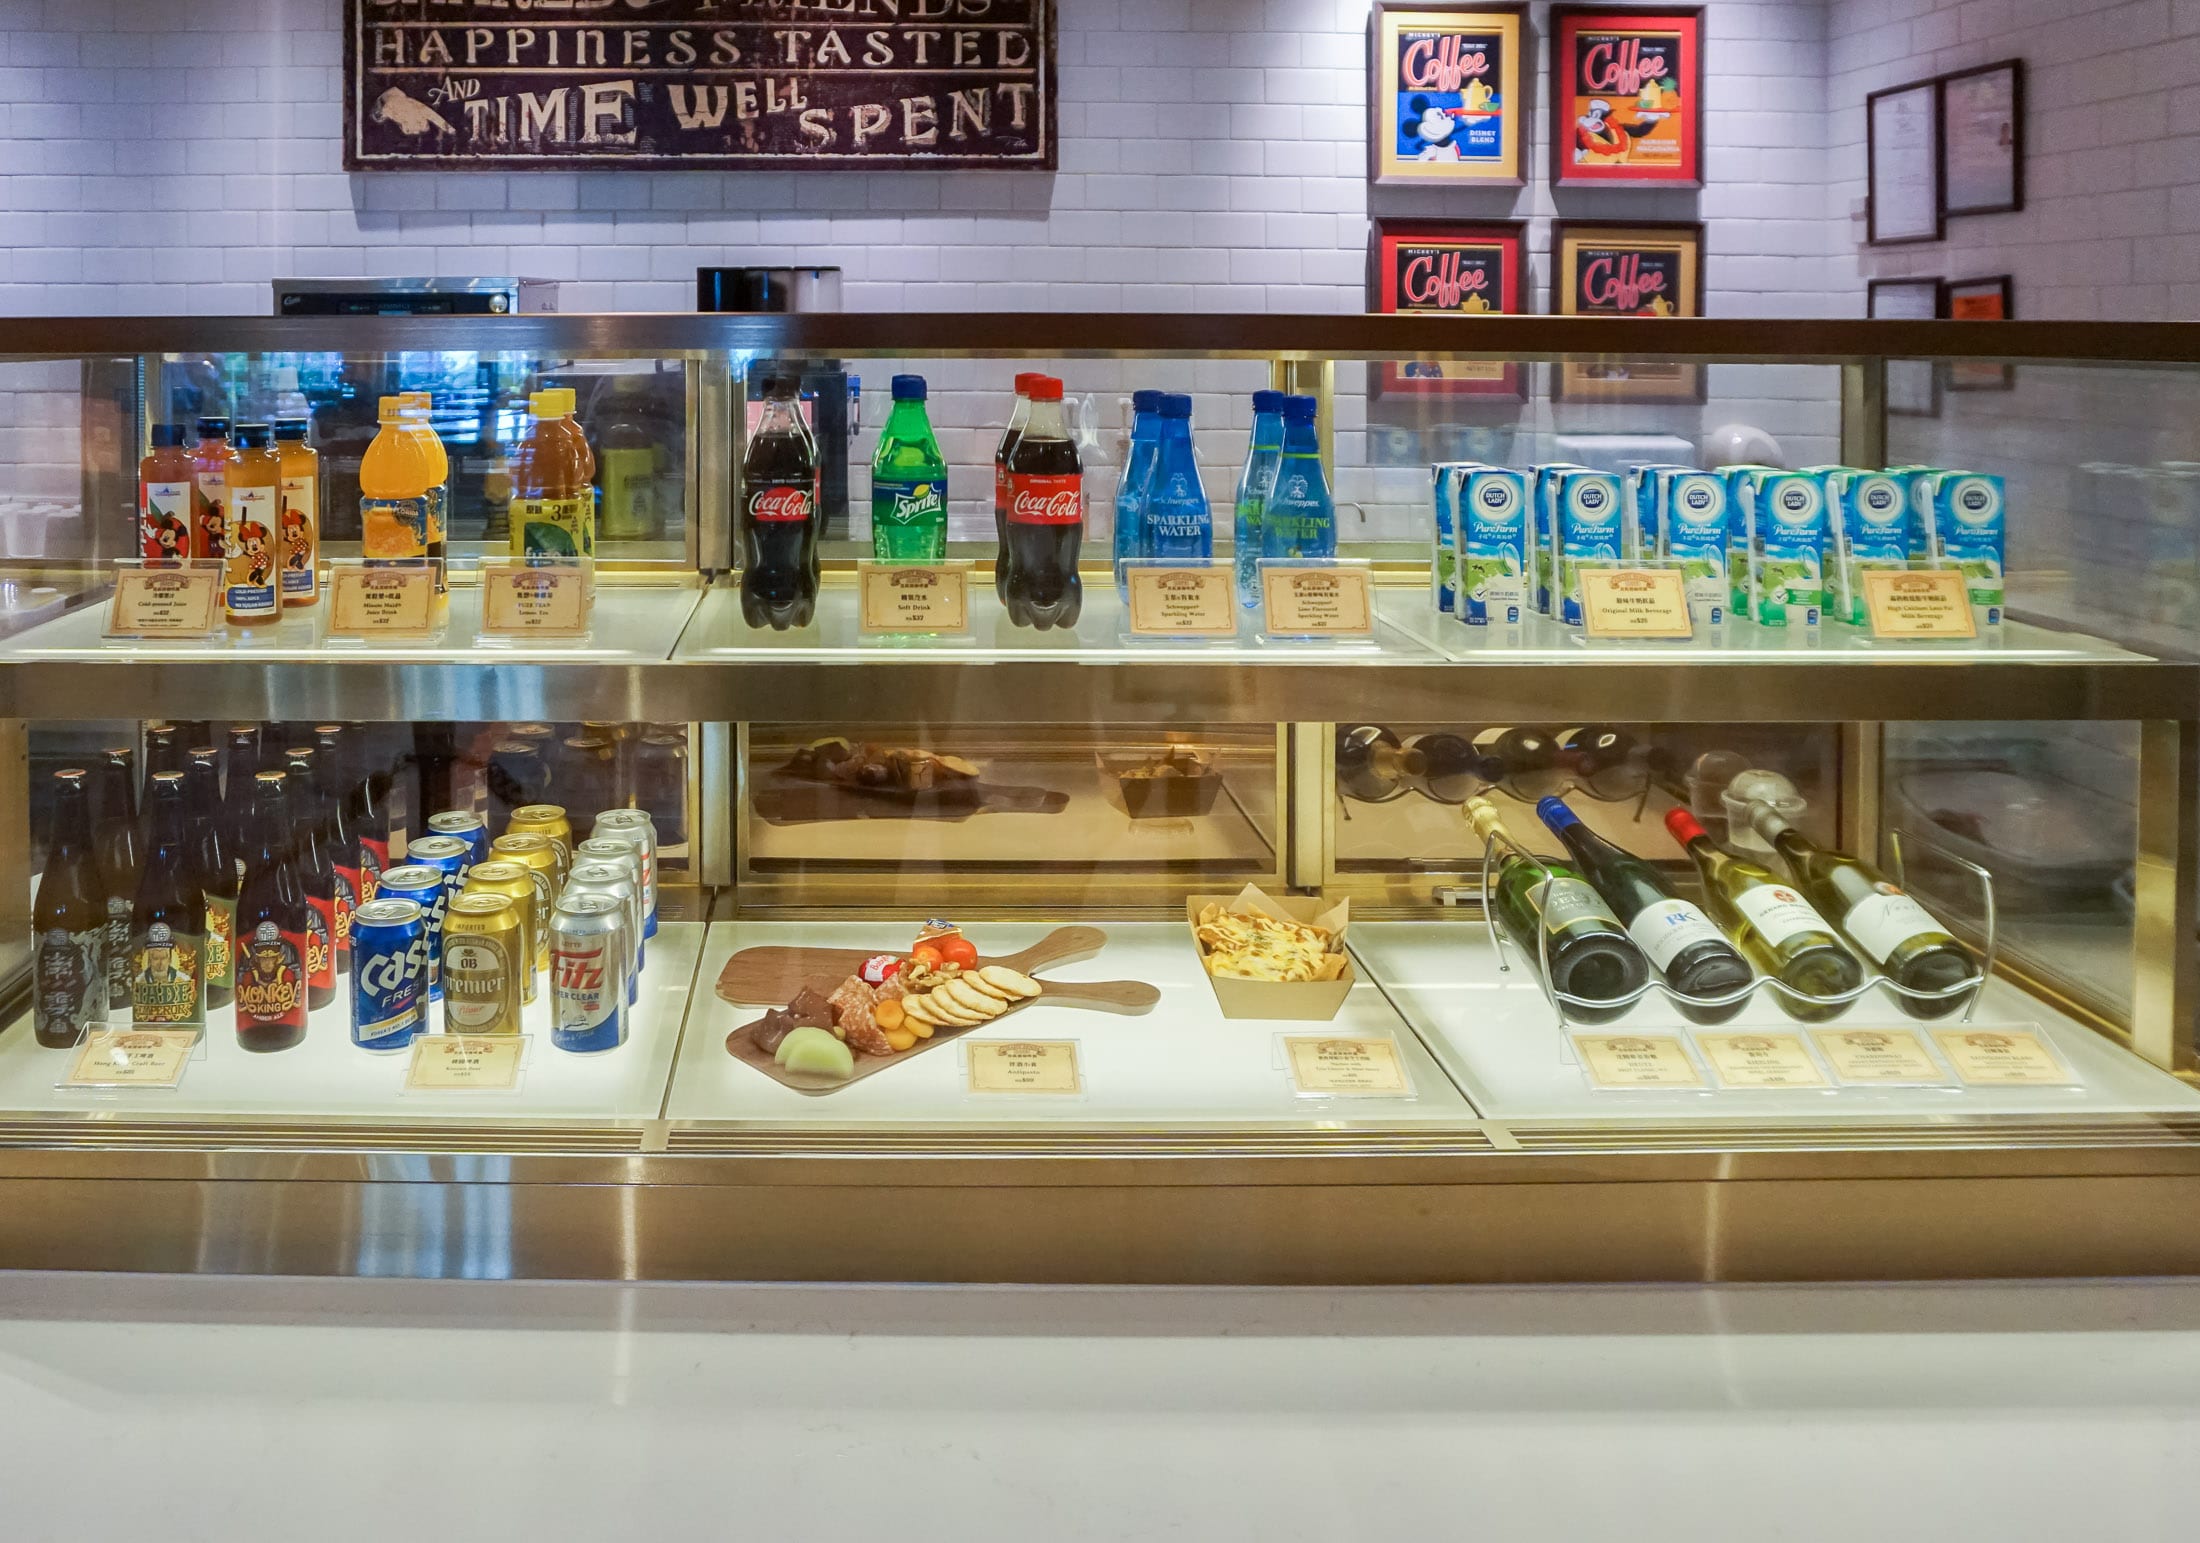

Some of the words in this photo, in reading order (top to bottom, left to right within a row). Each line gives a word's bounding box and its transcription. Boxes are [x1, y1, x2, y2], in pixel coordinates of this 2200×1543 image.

[375, 28, 742, 65] HAPPINESS
[774, 29, 1031, 65] TASTED
[1402, 35, 1490, 91] Coffee
[1585, 38, 1668, 95] Coffee
[428, 75, 481, 105] AND
[464, 79, 638, 144] TIME
[667, 77, 808, 130] WELL
[796, 82, 1034, 151] SPENT
[1404, 252, 1488, 308] Coffee
[1584, 253, 1667, 310] Coffee
[896, 491, 938, 519] Sprite
[1014, 490, 1080, 517] Coca-Cola
[1147, 514, 1210, 526] SPARKLING
[1158, 525, 1202, 537] WATER
[460, 958, 478, 969] OB
[550, 946, 604, 990] Fitz
[238, 980, 302, 1012] MONKEY
[257, 1003, 281, 1013] KING
[570, 992, 600, 1001] CLEAR
